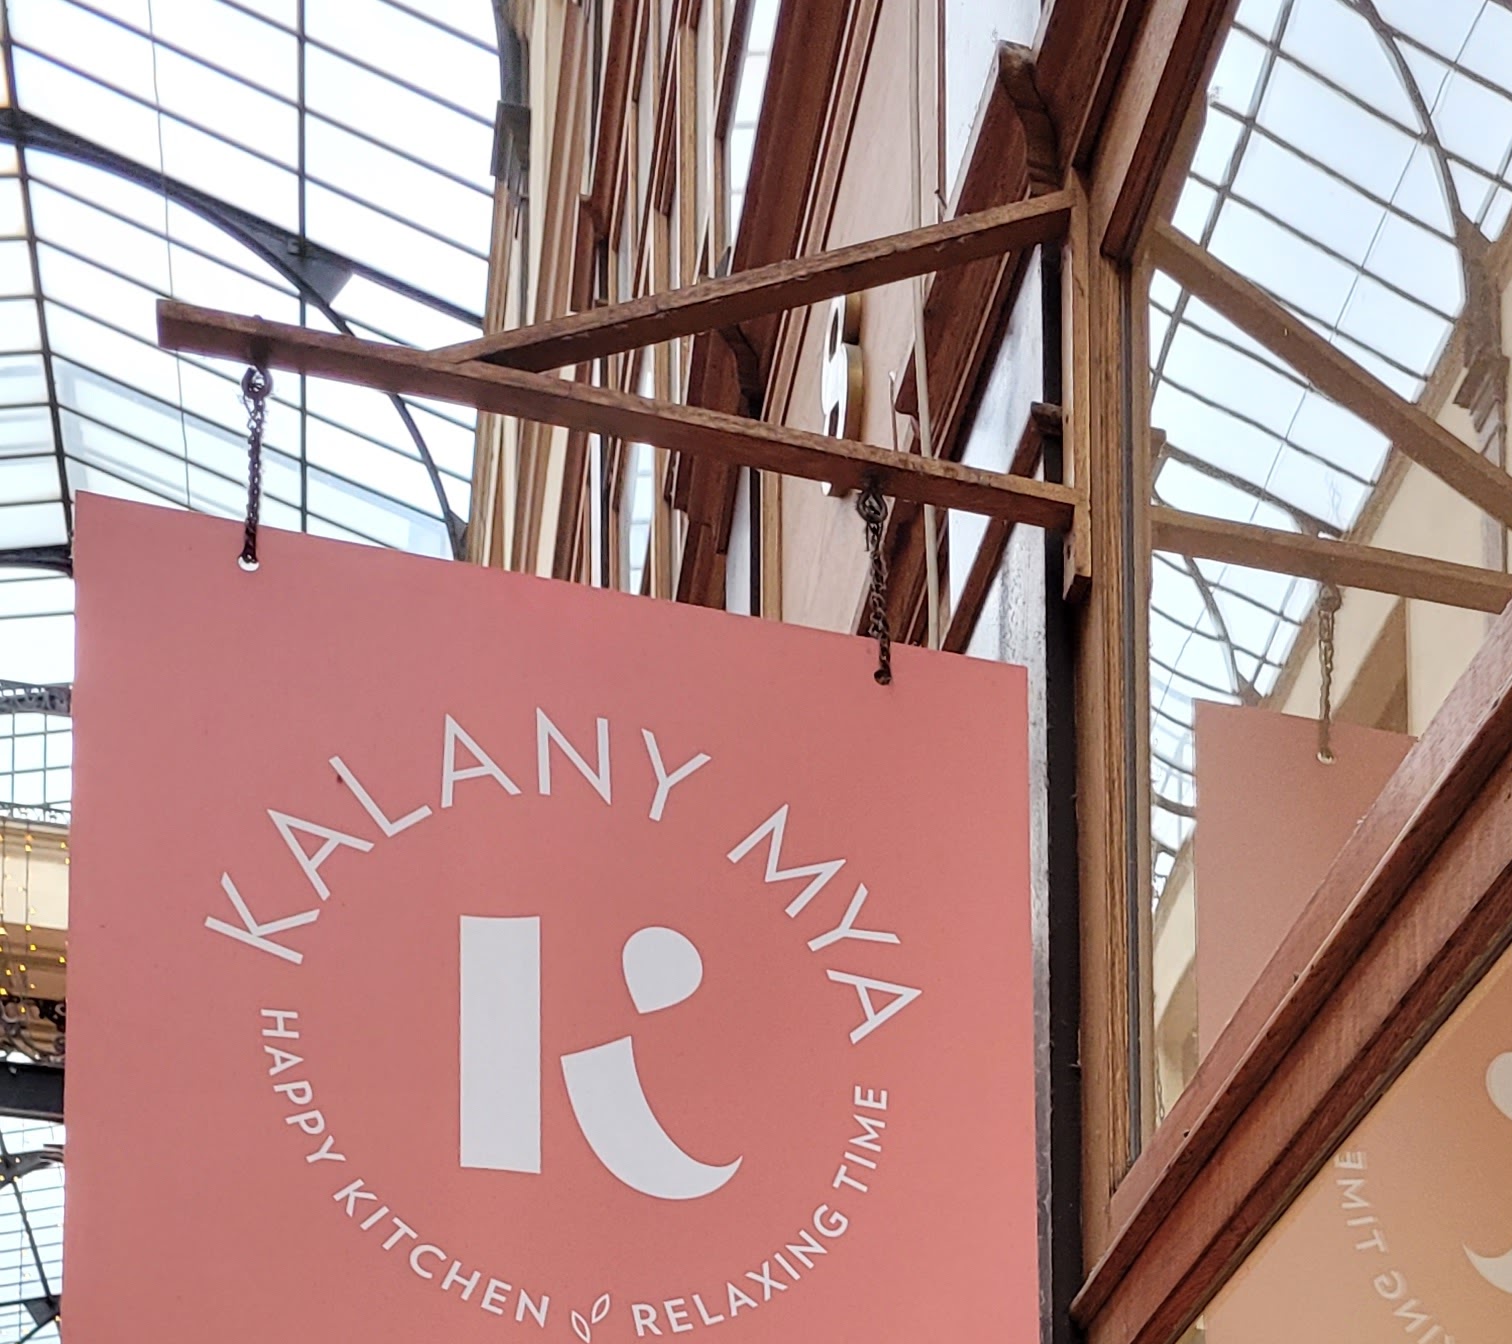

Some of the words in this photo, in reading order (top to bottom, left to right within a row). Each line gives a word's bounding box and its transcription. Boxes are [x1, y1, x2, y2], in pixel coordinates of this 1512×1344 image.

[205, 707, 711, 965] KALANY
[727, 804, 922, 1044] MYA
[259, 1008, 347, 1164] HAPPY
[332, 1177, 550, 1328] KITCHEN
[631, 1204, 849, 1337] RELAXING
[832, 1085, 888, 1193] TIME
